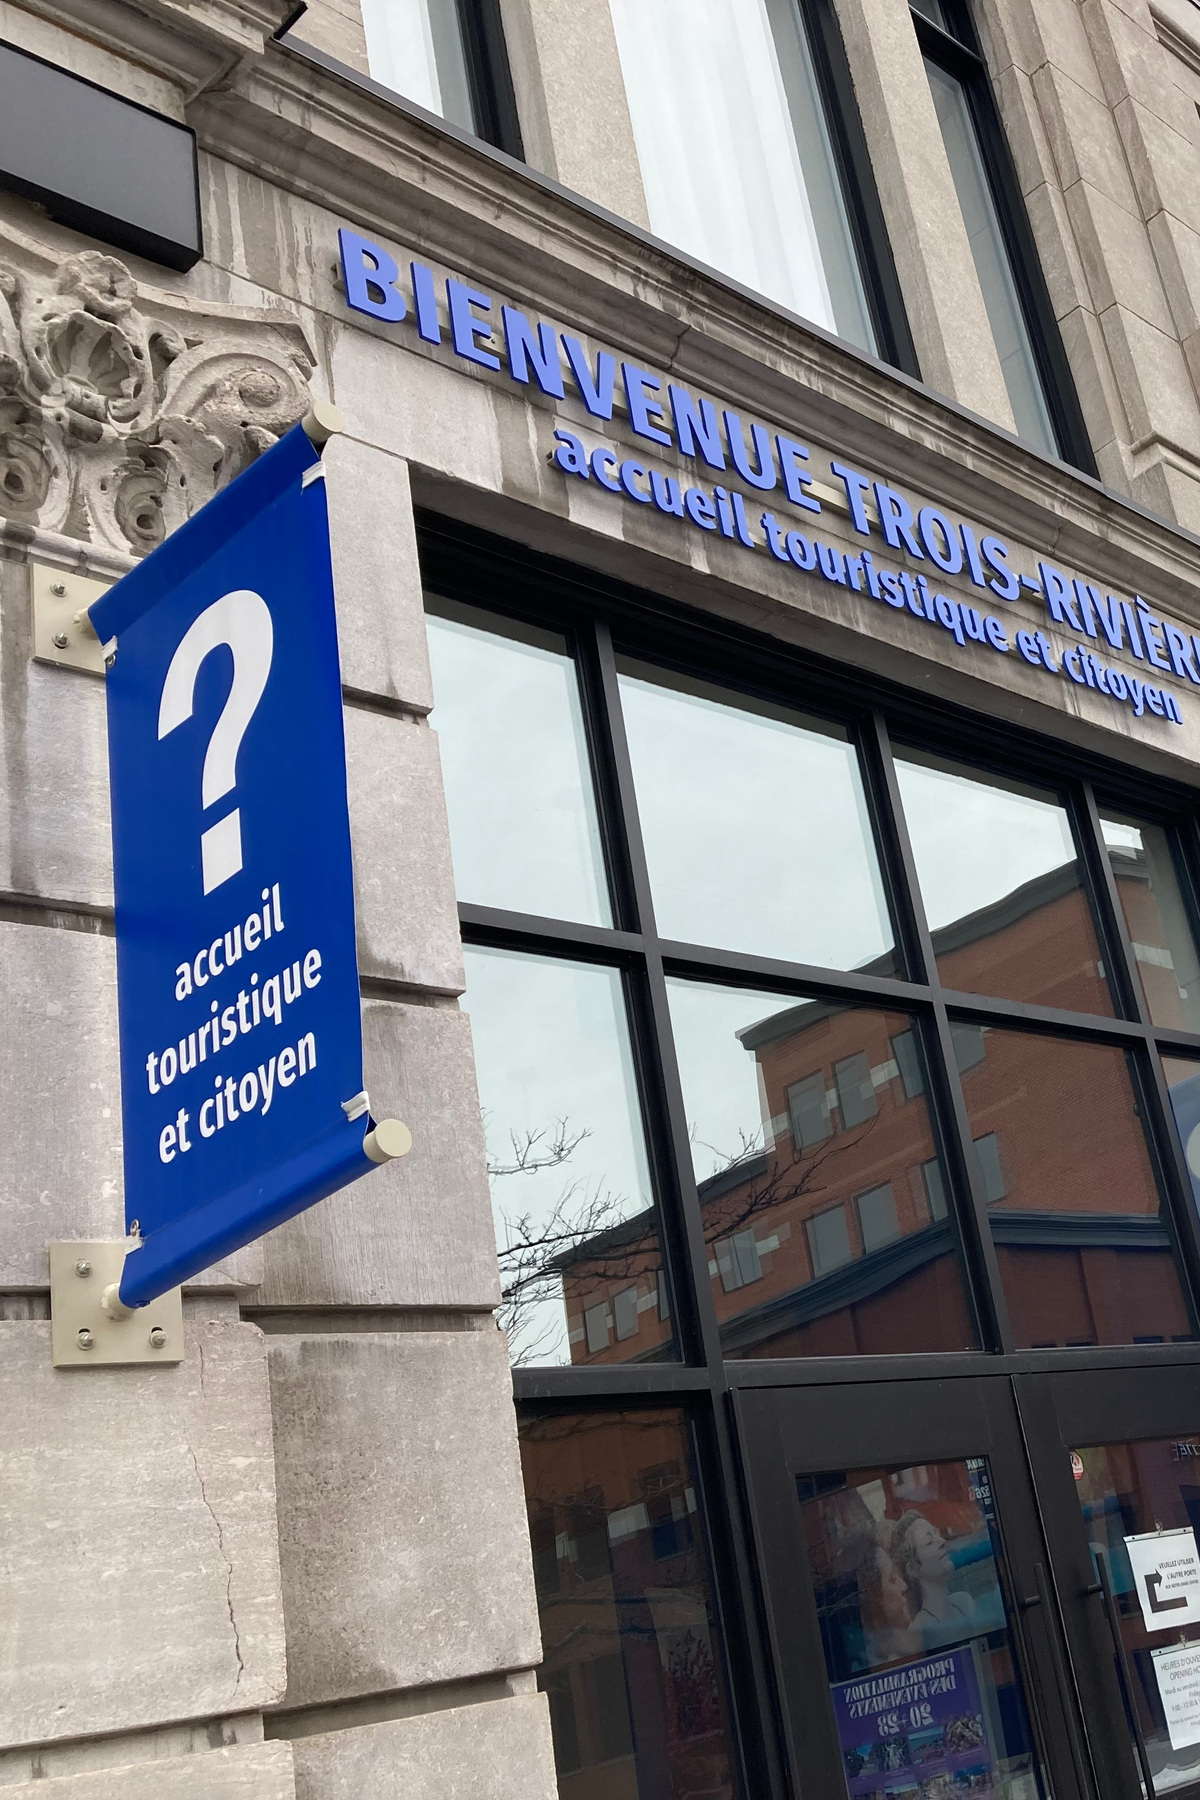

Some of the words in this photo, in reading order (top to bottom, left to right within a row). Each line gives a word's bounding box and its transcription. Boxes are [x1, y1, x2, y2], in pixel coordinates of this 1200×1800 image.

[339, 228, 821, 514] BIENVENUE
[553, 429, 756, 549] accueil
[761, 512, 1009, 653] touristique
[1017, 629, 1059, 673] et
[1062, 648, 1183, 724] citoyen
[175, 881, 286, 1001] accueil
[145, 947, 323, 1095] touristique
[158, 1107, 193, 1164] et
[198, 1031, 318, 1139] citoyen
[1161, 1660, 1180, 1671] HEURES
[1170, 1668, 1193, 1680] OPENING
